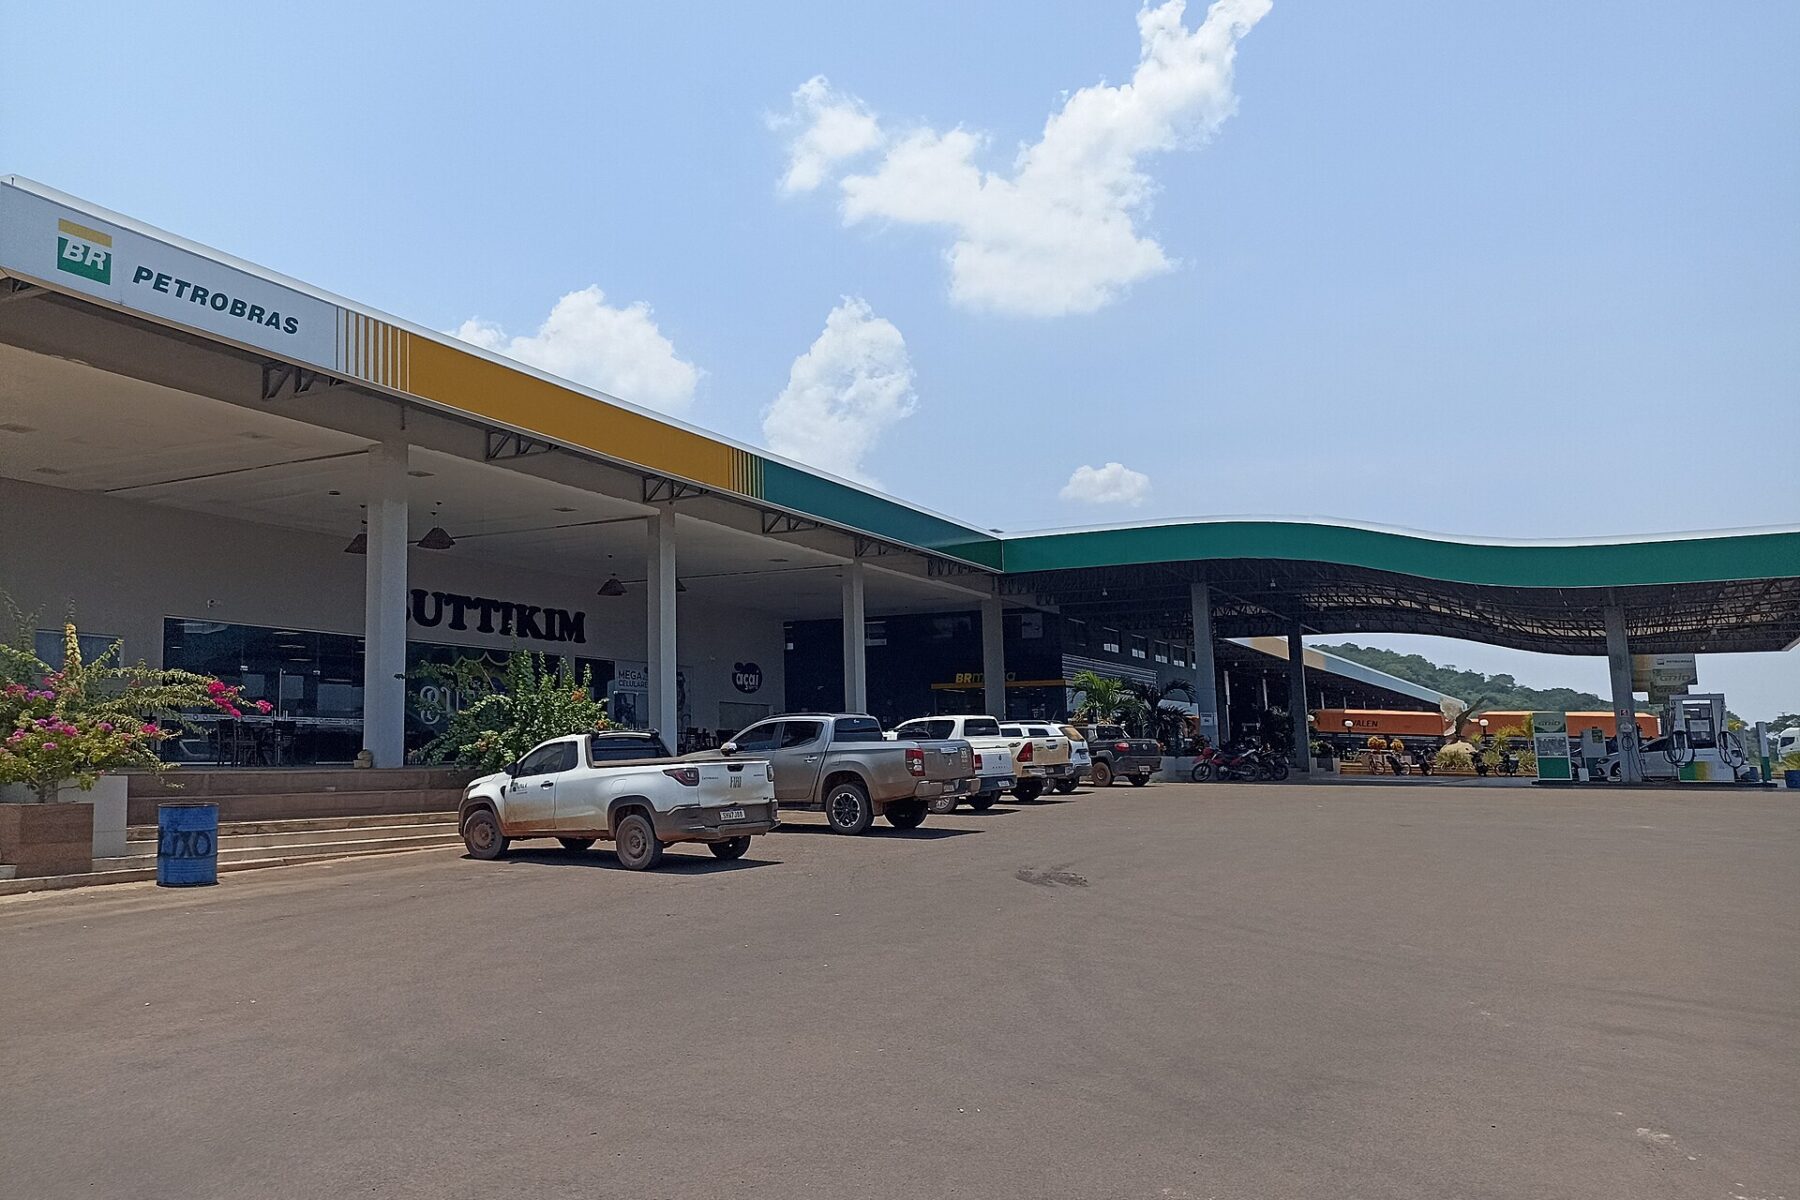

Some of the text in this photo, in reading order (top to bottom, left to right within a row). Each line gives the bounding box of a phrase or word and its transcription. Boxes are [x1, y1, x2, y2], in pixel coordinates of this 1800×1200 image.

[62, 239, 107, 271] BR
[132, 265, 299, 335] PETROBRAS
[406, 588, 587, 644] UTTIKIM
[618, 670, 642, 680] MEGA
[955, 671, 1017, 684] BRma
[618, 679, 649, 689] CELULARE
[729, 775, 742, 789] FIAT
